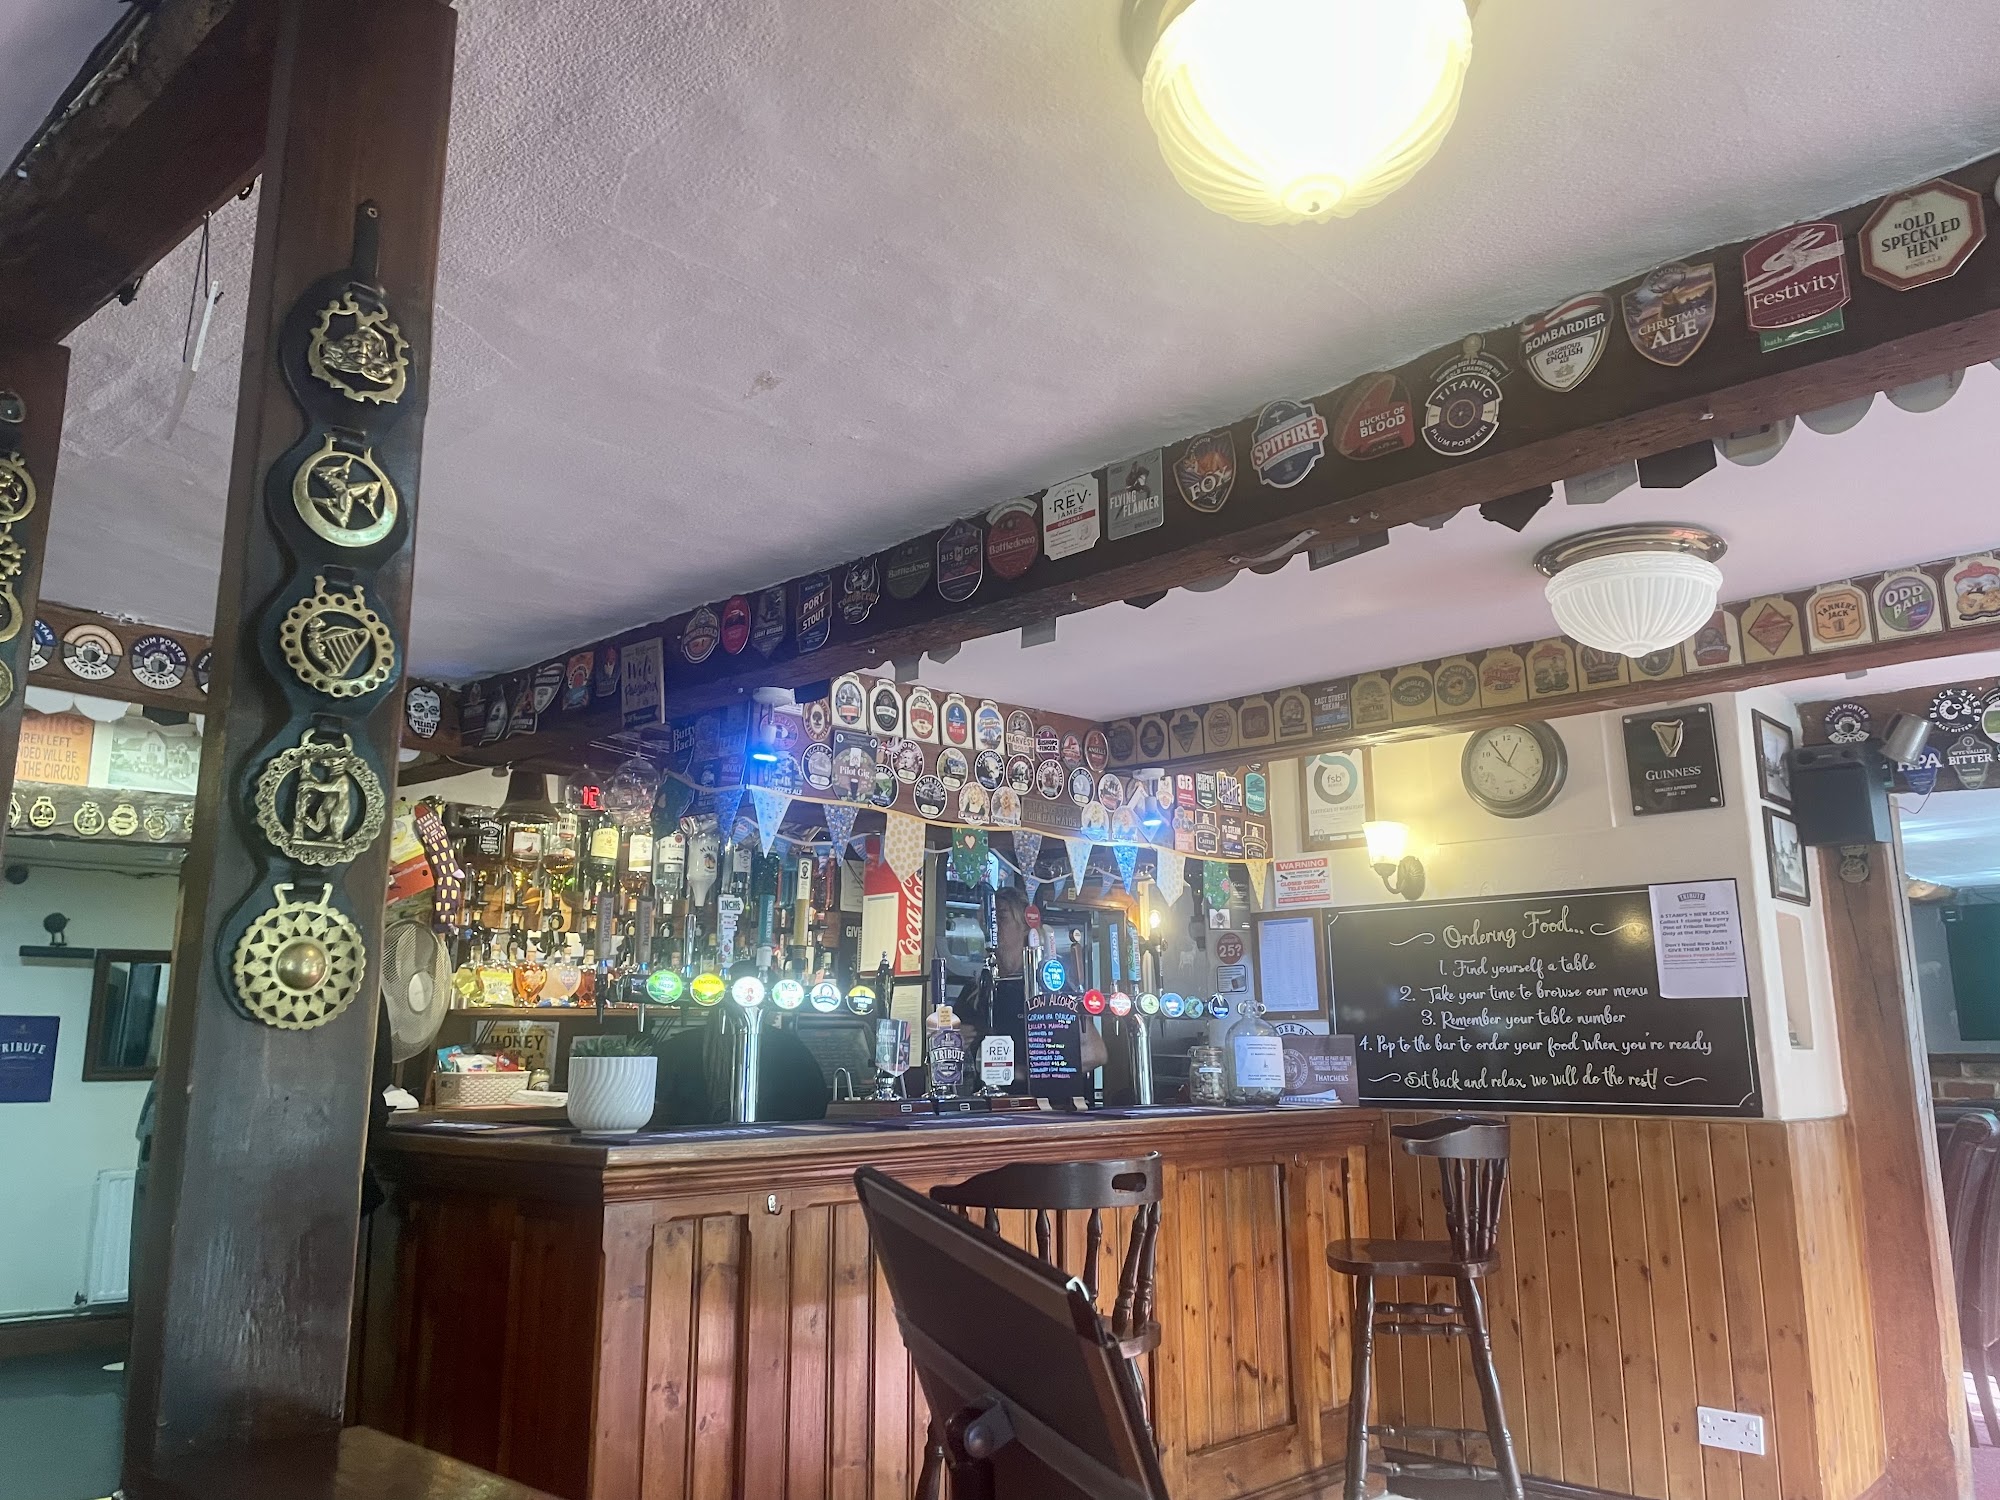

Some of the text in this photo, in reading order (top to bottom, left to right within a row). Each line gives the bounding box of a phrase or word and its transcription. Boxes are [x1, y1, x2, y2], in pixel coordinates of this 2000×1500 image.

[1894, 211, 1935, 231] "OLD
[1881, 218, 1960, 252] SPECKLED
[1906, 235, 1948, 258] HEN"
[1752, 272, 1840, 309] Festivity
[1638, 305, 1707, 336] CHRISTMAS
[1525, 312, 1605, 354] BOMBARDIER
[1650, 319, 1699, 349] ALE
[1546, 347, 1583, 365] ENGLISH
[1435, 379, 1493, 401] TITANIC
[1359, 406, 1405, 427] BUCKET OF
[1359, 414, 1406, 438] BLOOD
[1254, 420, 1319, 465] SPITFIRE
[1430, 424, 1488, 448] PLUM PORTER
[1188, 465, 1229, 502] FOX
[1053, 490, 1088, 512] REV
[1110, 489, 1137, 510] FLYING
[1123, 495, 1160, 518] FLANKER
[1057, 506, 1084, 520] JAMES
[988, 536, 1036, 556] Battledown
[803, 591, 825, 614] PORT
[1883, 584, 1924, 608] ODD
[1817, 601, 1857, 618] TANNER'S
[1827, 610, 1849, 621] JACK
[1893, 595, 1924, 620] BALL
[802, 608, 825, 631] STOUT
[34, 619, 54, 641] STAR
[135, 636, 187, 663] PLUM PORTER
[70, 658, 108, 676] TITANIC
[138, 668, 175, 686] TITANIC
[1314, 693, 1347, 706] EAST STREET
[1321, 701, 1340, 711] CREAM
[1400, 693, 1425, 704] COUNTY
[1929, 689, 1982, 722] BLACK SHEEP
[1825, 703, 1869, 722] PLUM PORTER
[673, 726, 695, 741] Butty
[1935, 721, 1973, 733] BEST BITTER
[46, 734, 72, 748] LEFT
[673, 735, 695, 753] Bach
[1007, 736, 1033, 747] HARVEST
[43, 748, 78, 763] WILL BE
[1947, 753, 1993, 766] BITTER
[23, 760, 81, 781] THE CIRCUS
[722, 764, 741, 773] HOOKY
[839, 765, 871, 779] Pilot Gig
[1327, 774, 1341, 783] fsb
[1645, 766, 1701, 781] GUINNESS
[1280, 860, 1324, 870] WARNING
[1678, 892, 1706, 902] TRIBUTE
[601, 901, 613, 943] THATCHERS
[1442, 904, 1585, 948] Ordering Food...
[1219, 945, 1242, 958] 25?
[1439, 953, 1596, 980] 1. Find yourself a table
[1399, 980, 1649, 1005] 2. Take your time to browse our menu
[1027, 993, 1079, 1013] LOW ALCOHOL
[1027, 1012, 1076, 1022] GORAM DRAUGHT
[1420, 1004, 1626, 1030] 3. Remember your table number
[0, 1041, 47, 1055] RIBUTE
[491, 1034, 544, 1049] HONEY
[989, 1046, 1010, 1056] REV
[1358, 1030, 1712, 1059] 4. Pop to the bar to order your food when you're ready
[934, 1050, 965, 1061] TRIBUTE
[1315, 1073, 1349, 1081] THATCHERS
[1404, 1062, 1658, 1091] Sit back and relax, we will do the rest!
